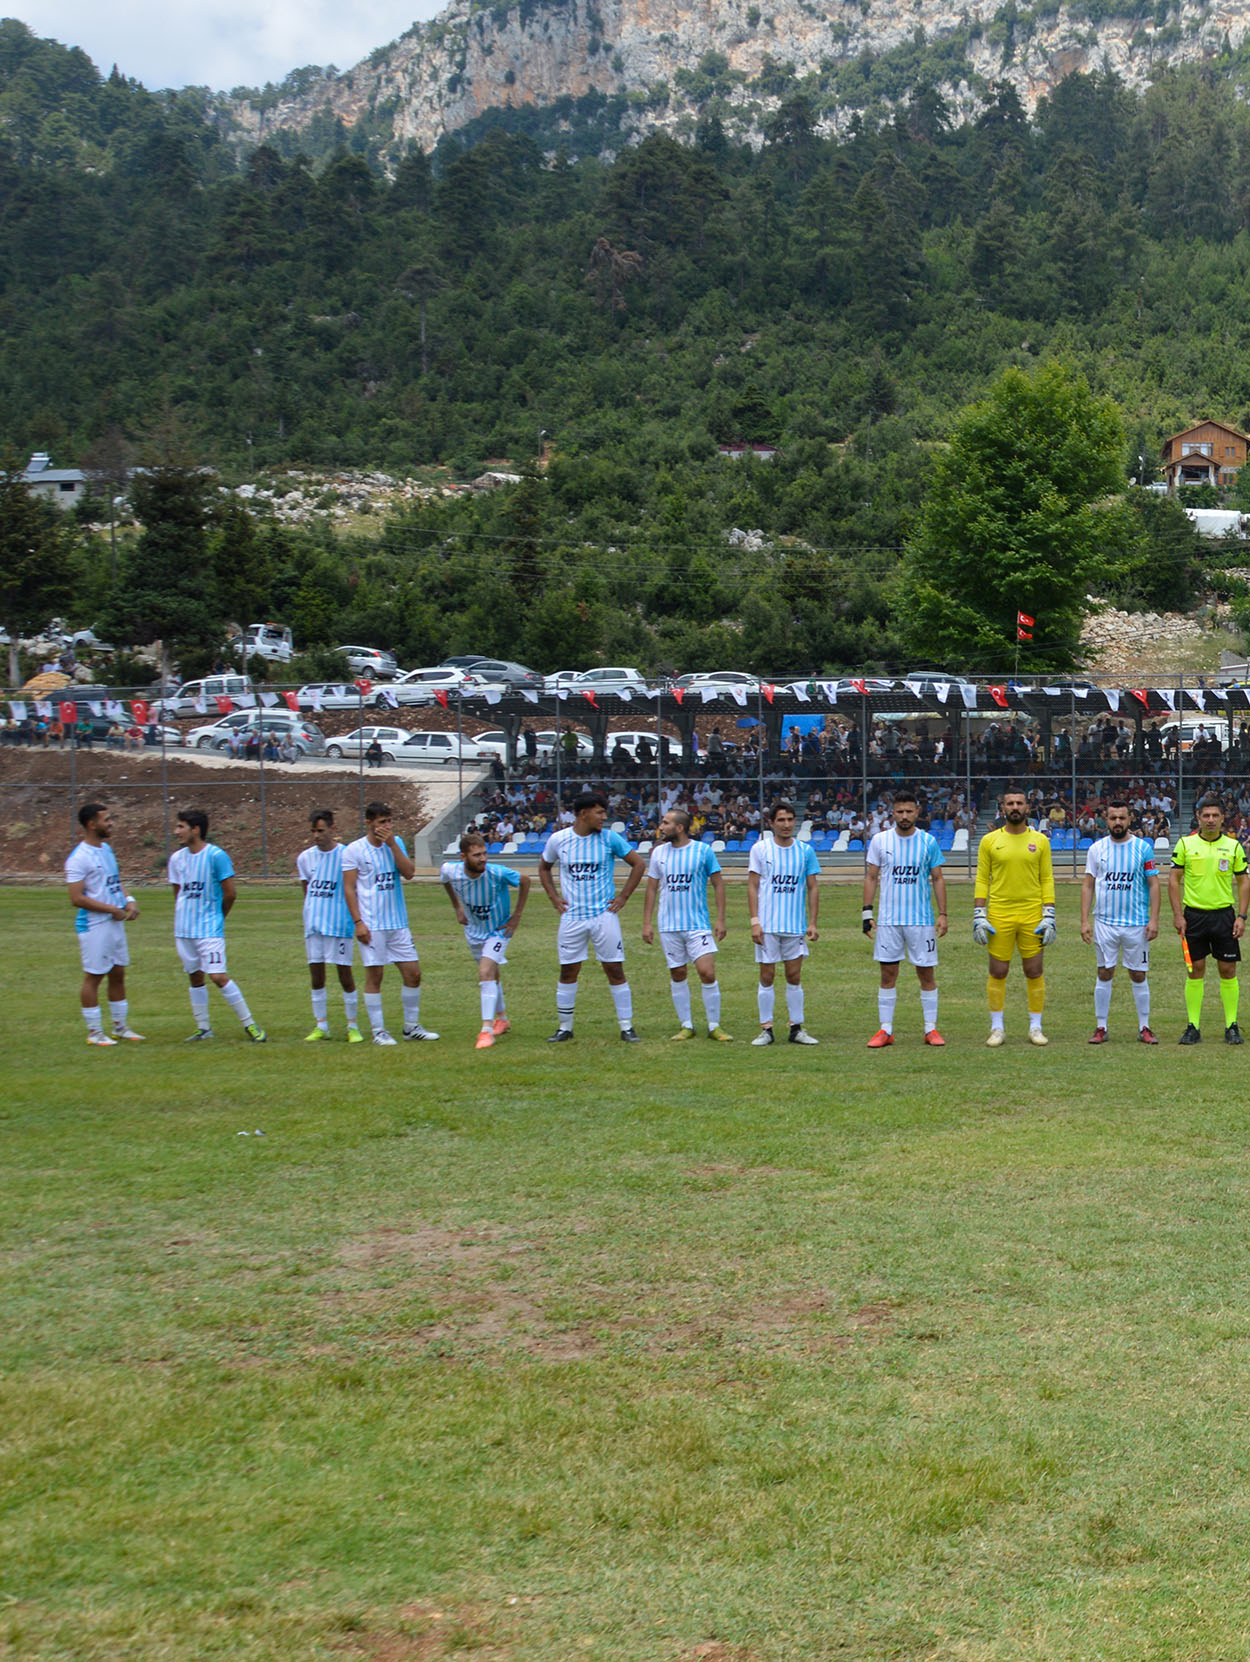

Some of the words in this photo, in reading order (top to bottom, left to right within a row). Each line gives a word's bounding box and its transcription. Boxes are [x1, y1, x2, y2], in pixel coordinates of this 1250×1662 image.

[568, 862, 600, 874] KUZU
[892, 865, 920, 876] KUZU
[572, 874, 595, 882] TARIM
[666, 873, 693, 884] KUZU
[771, 874, 799, 886] KUZU
[894, 877, 917, 885] TARIM
[1105, 871, 1134, 883] KUZU
[668, 885, 690, 893] TARIM
[773, 886, 796, 894] TARIM
[1107, 883, 1132, 892] TARIM
[701, 934, 709, 946] 2
[926, 938, 936, 953] 17
[493, 941, 502, 953] 8
[209, 951, 222, 965] 11
